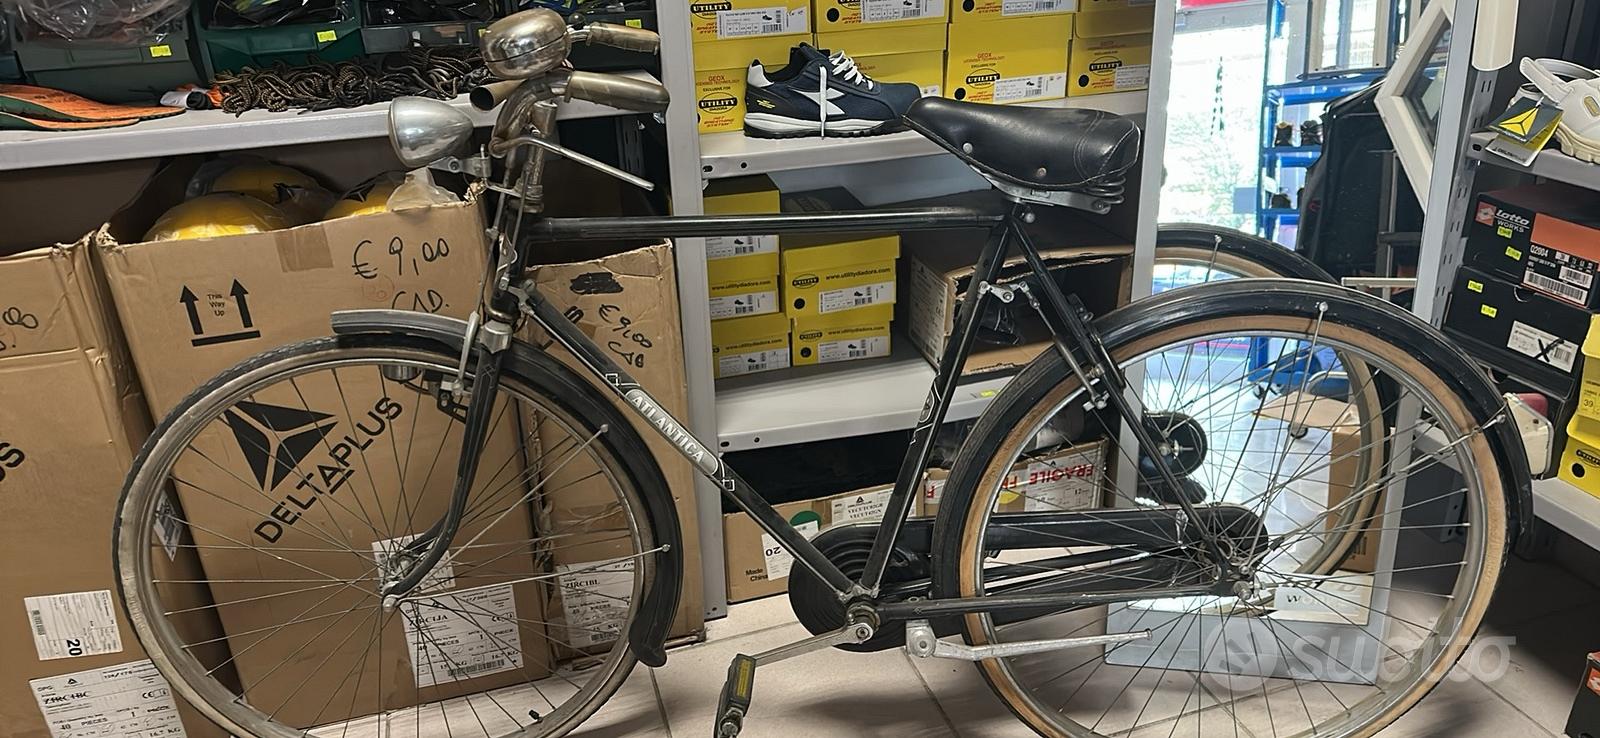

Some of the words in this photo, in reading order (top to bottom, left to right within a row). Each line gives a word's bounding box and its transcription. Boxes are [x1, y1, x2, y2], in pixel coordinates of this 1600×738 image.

[692, 3, 729, 12] UTILITY
[1091, 62, 1121, 72] UTILITY
[967, 74, 999, 84] UTILITY
[701, 98, 736, 108] UTILITY
[1496, 209, 1530, 226] Lotto
[1496, 219, 1525, 233] WORKS
[351, 239, 378, 279] €
[207, 293, 223, 301] This
[208, 301, 225, 309] Way
[214, 309, 225, 318] Up
[631, 395, 705, 464] ATLANTICA
[254, 397, 403, 544] DELTAPLUS
[765, 546, 781, 557] 20
[745, 568, 764, 576] Made
[750, 574, 769, 582] China
[66, 637, 83, 657] 20
